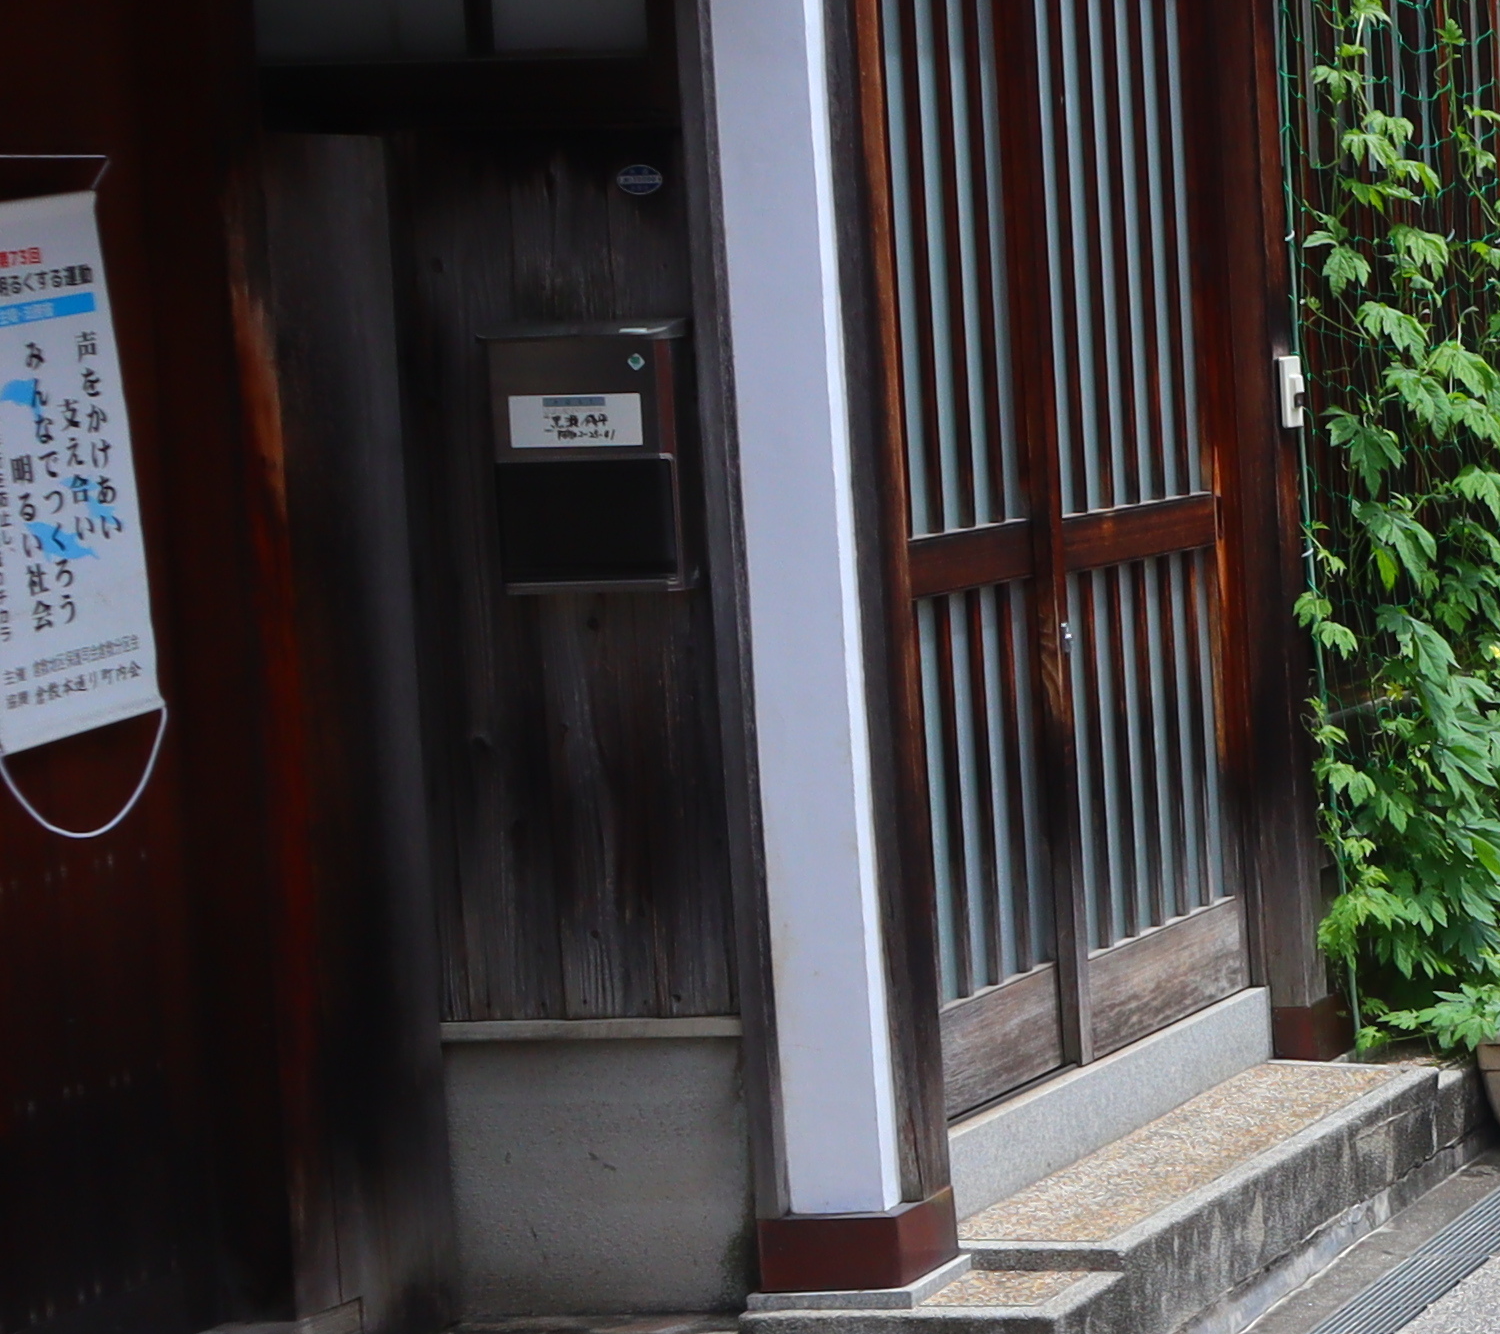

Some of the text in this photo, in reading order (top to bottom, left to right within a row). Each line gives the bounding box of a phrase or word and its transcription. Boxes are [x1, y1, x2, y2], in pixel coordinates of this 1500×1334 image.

[25, 341, 76, 624] みんなでつくろう
[57, 398, 96, 540] 支え合い
[75, 330, 123, 540] 声をかけあい
[10, 454, 54, 632] 明るい社会
